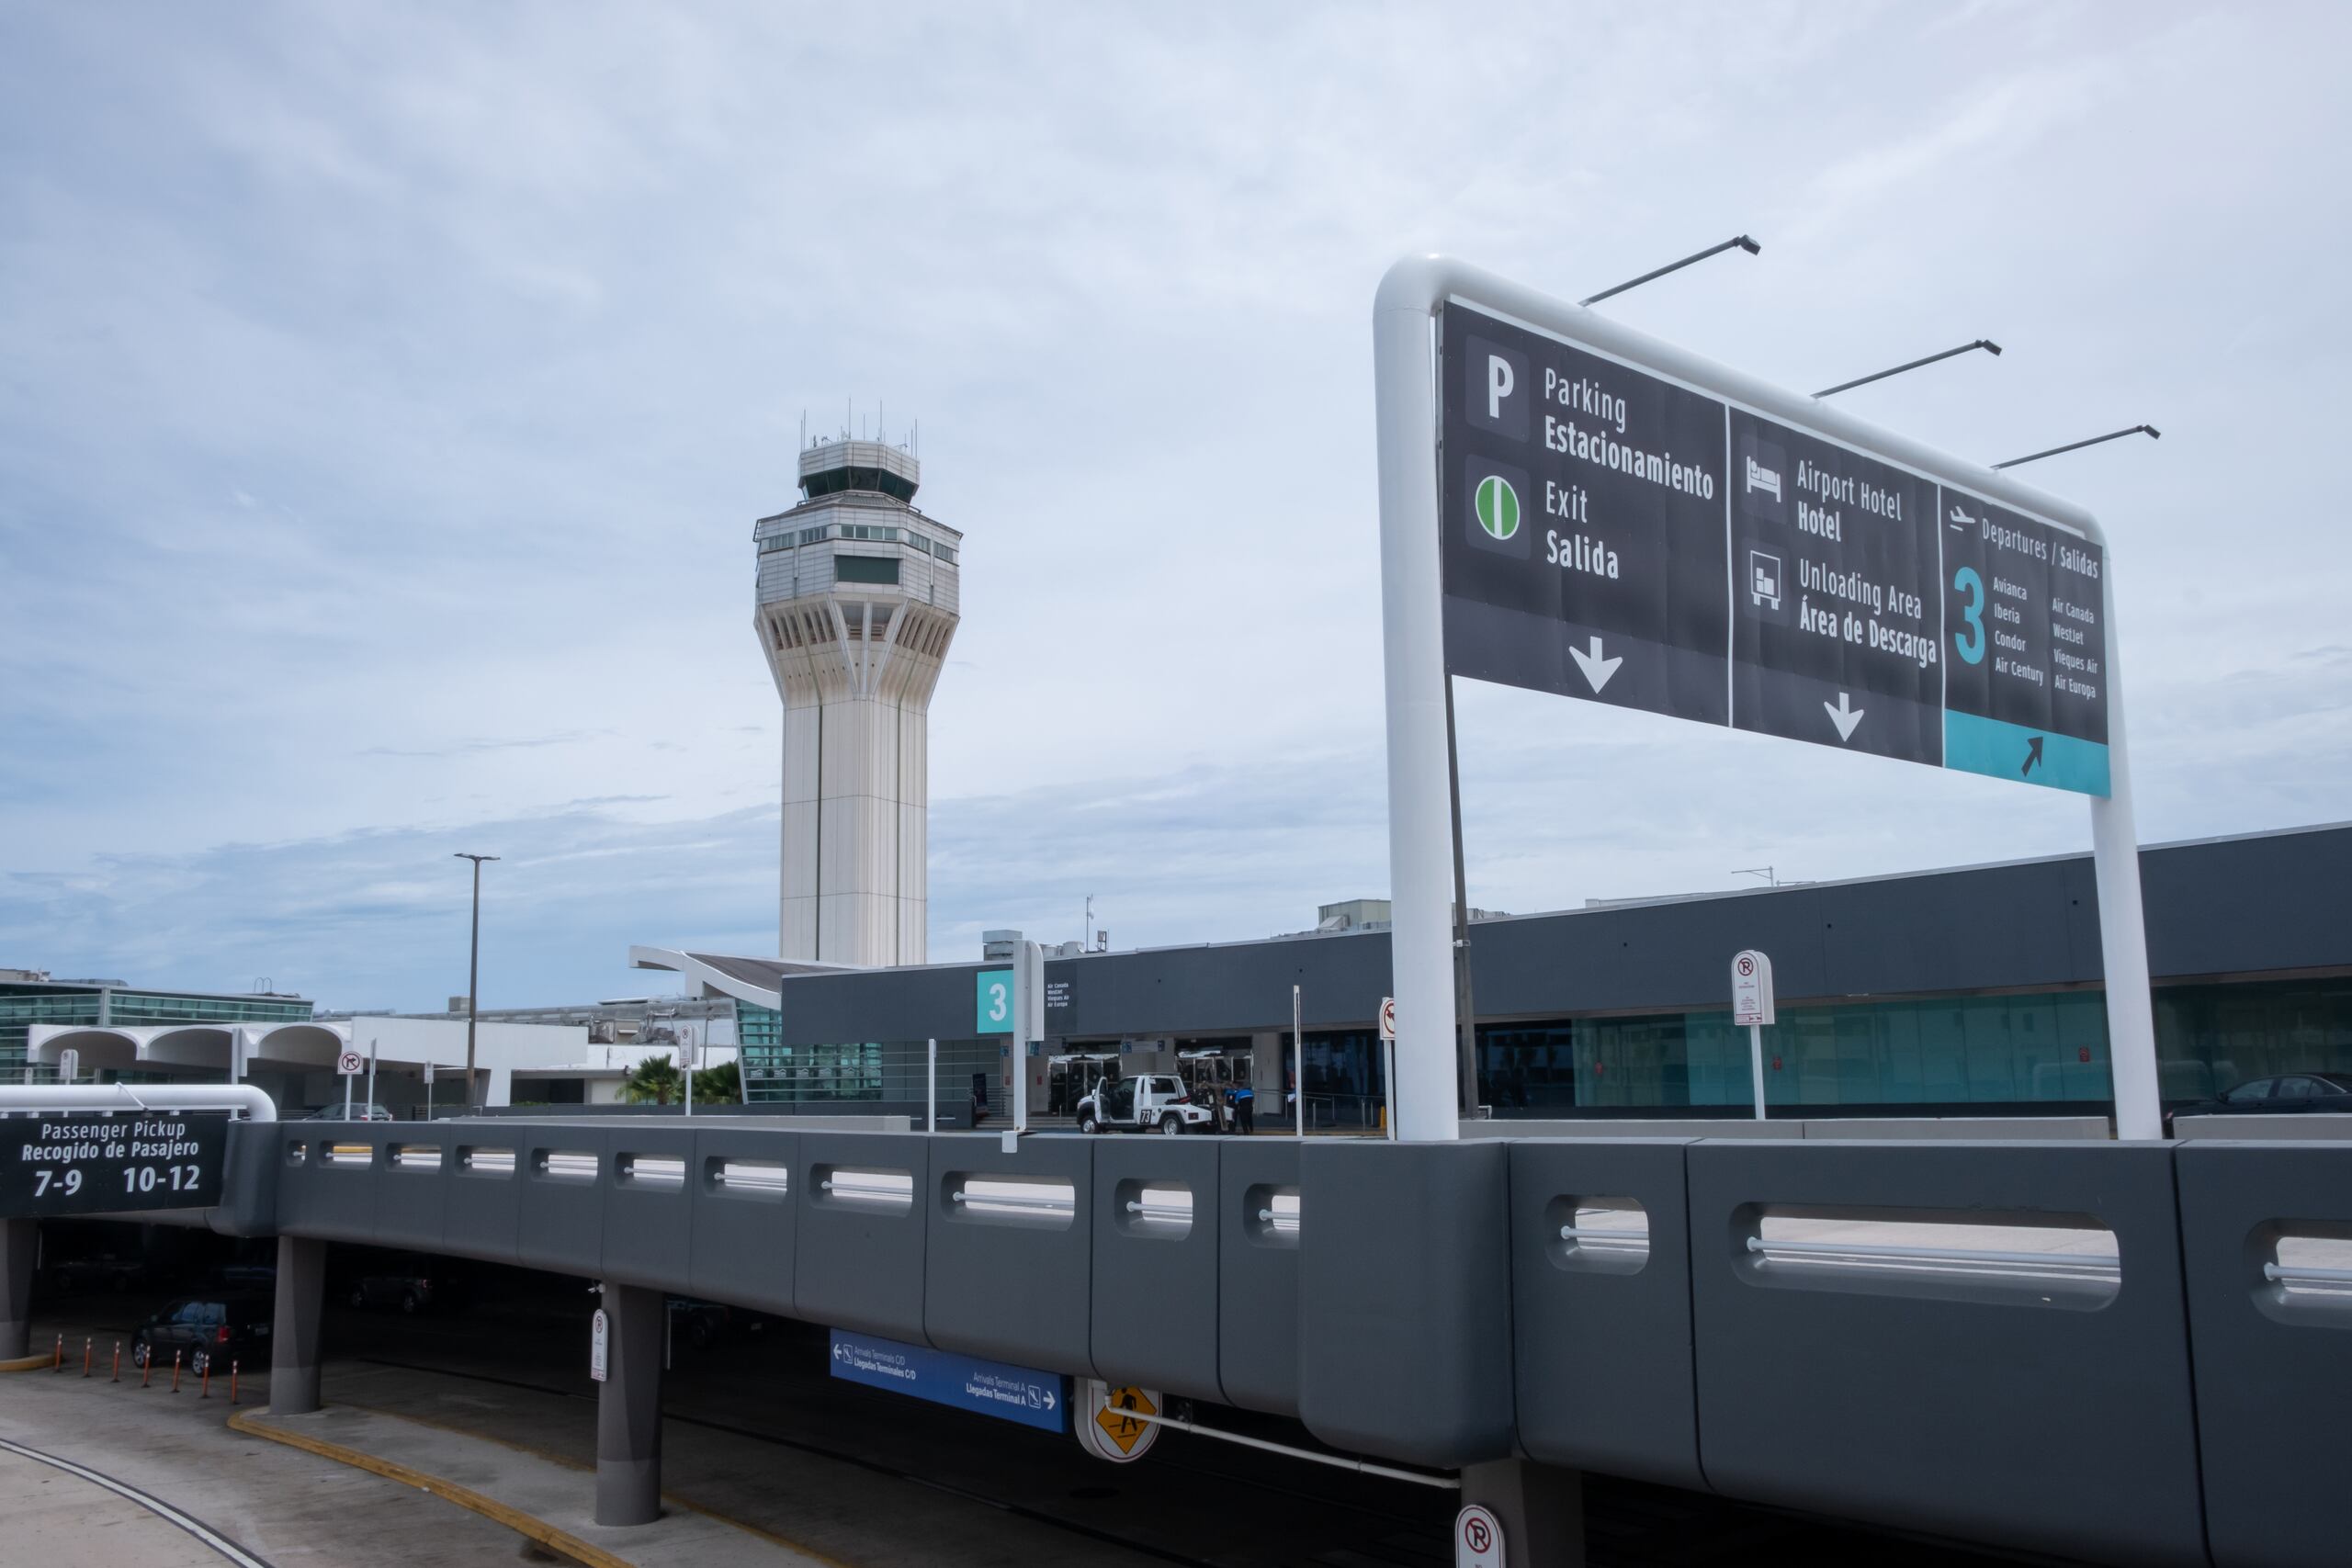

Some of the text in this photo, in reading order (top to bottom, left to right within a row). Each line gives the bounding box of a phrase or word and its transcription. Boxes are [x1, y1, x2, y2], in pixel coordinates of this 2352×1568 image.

[1489, 355, 1514, 418] P
[1545, 367, 1625, 434] Parking
[1545, 414, 1713, 500] Estacionamiento
[1545, 480, 1588, 524] Exit
[1797, 460, 1902, 521] Airport Hotel
[1798, 501, 1841, 542] Hotel
[1546, 529, 1620, 580] Salida
[1982, 518, 2047, 560] Departures
[2060, 546, 2098, 579] Salidas
[1800, 558, 1922, 620] Unloading Area
[1993, 577, 2028, 601] Avianca
[1954, 567, 1985, 665] 3
[1994, 603, 2020, 625] Iberia
[2052, 597, 2095, 625] Air Canada
[1800, 594, 1937, 669] Área de Descarga
[1995, 630, 2026, 652] Condor
[2052, 623, 2084, 645] WestJet
[1995, 657, 2043, 687] Air Century
[2053, 649, 2098, 674] Vieques Air
[2054, 674, 2097, 700] Air Europa
[989, 983, 1007, 1021] 3
[1140, 1110, 1151, 1123] 73
[41, 1120, 186, 1143] Passenger Pickup
[22, 1139, 199, 1164] Recogido de Pasajero
[34, 1168, 83, 1197] 7-9
[123, 1165, 200, 1193] 10-12
[854, 1346, 872, 1359] Arrivals
[895, 1355, 906, 1366] C/D
[854, 1357, 916, 1380] Llegadas Terminales C/D
[967, 1382, 1026, 1406] Llegadas Terminal A
[974, 1371, 1026, 1393] Arrivals Terminal A
